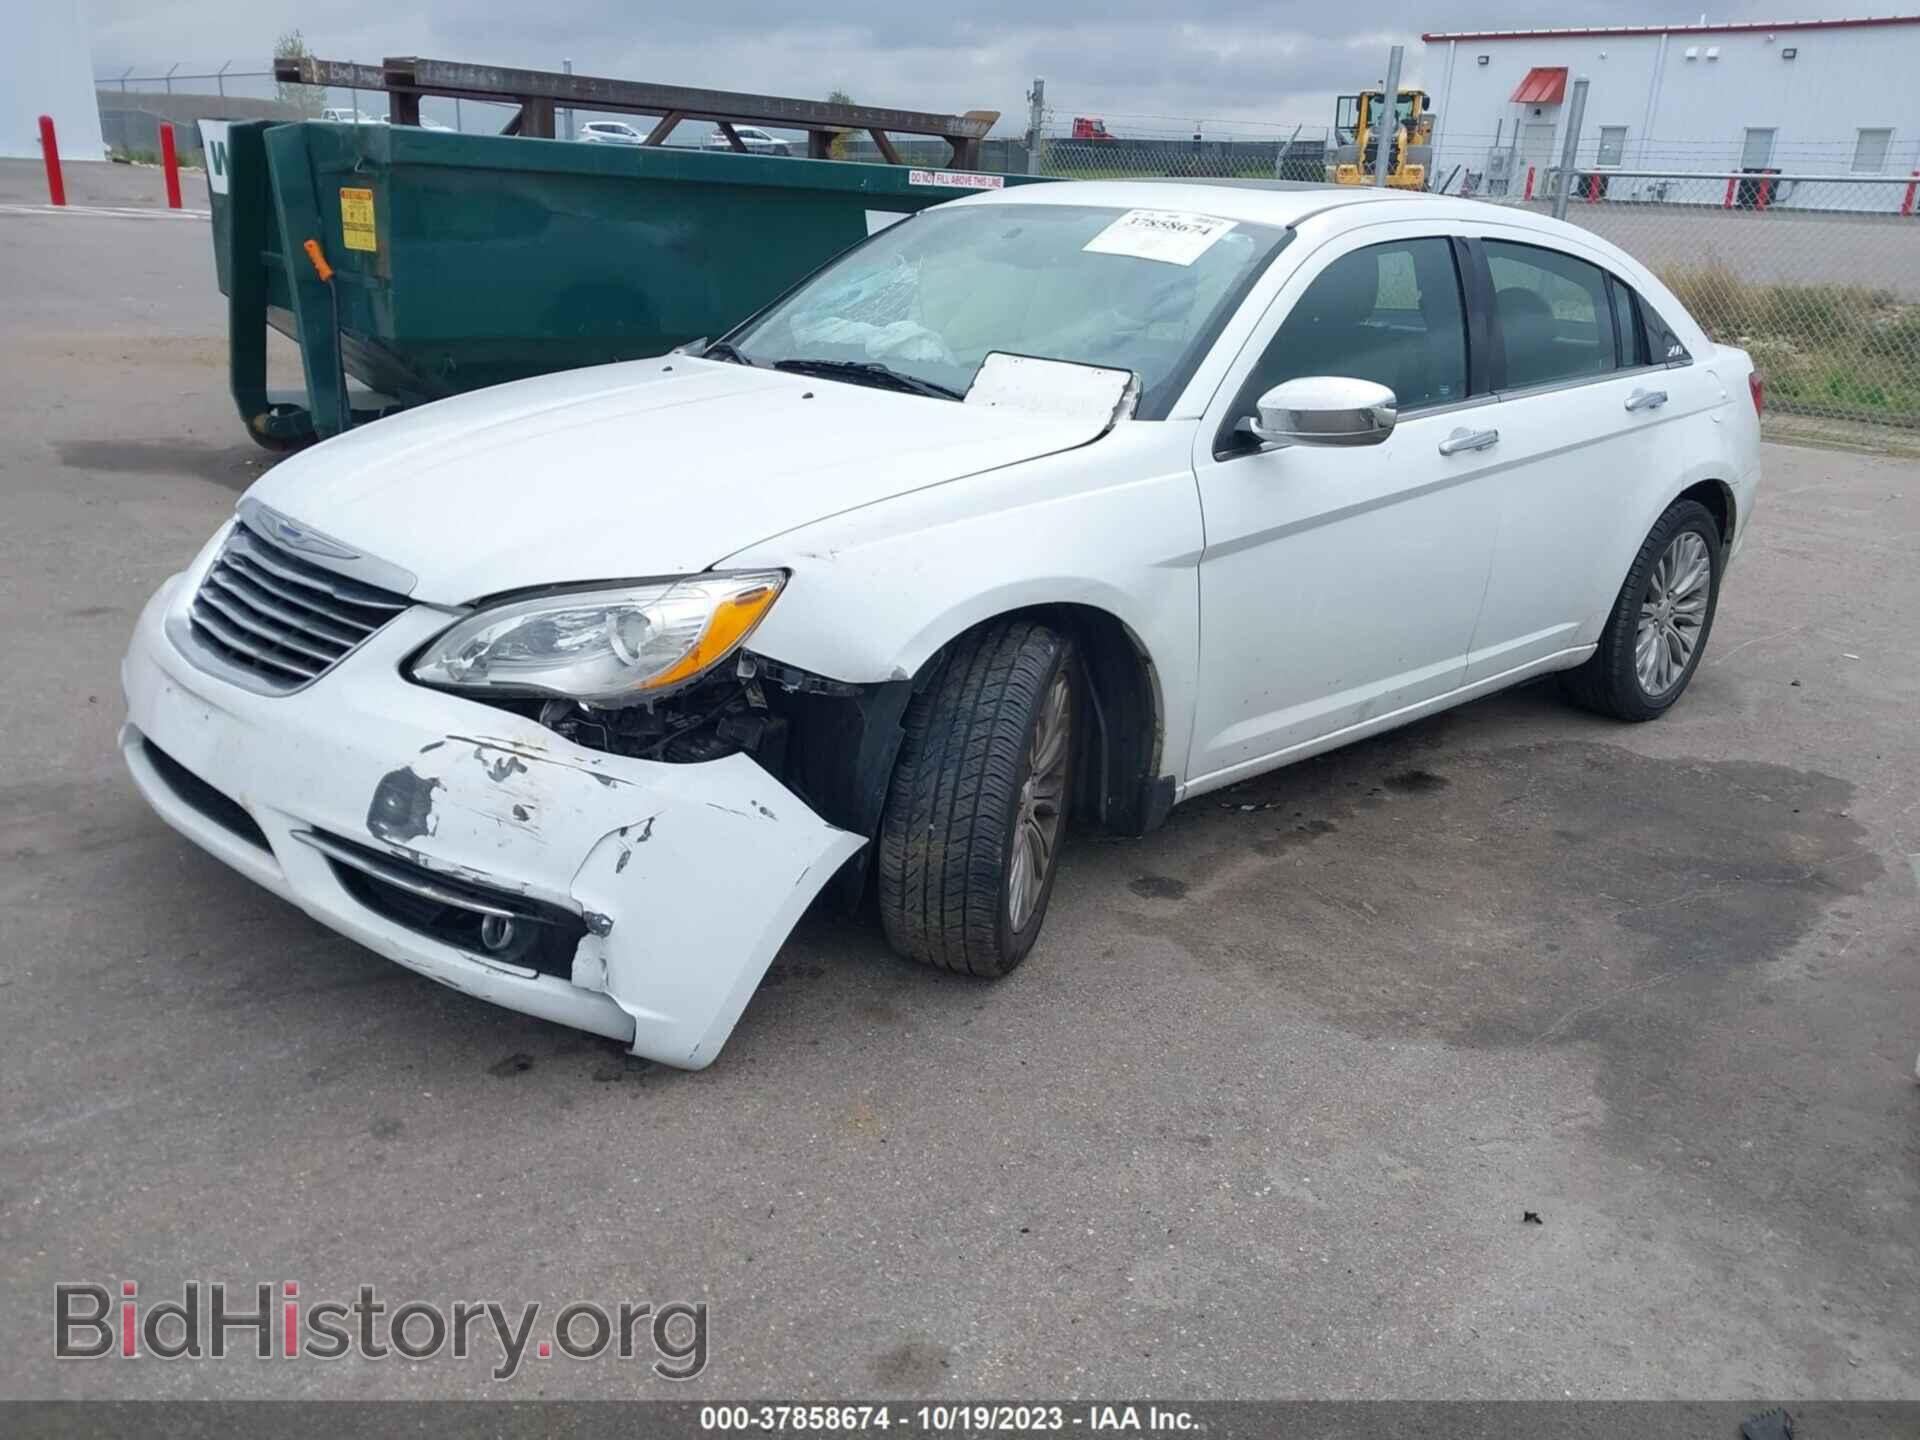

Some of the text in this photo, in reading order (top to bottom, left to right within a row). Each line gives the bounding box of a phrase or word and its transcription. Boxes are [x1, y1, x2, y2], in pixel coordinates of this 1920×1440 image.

[911, 171, 921, 183] DO
[936, 174, 950, 185] FILL
[951, 175, 972, 187] ABOVE
[974, 176, 987, 188] THIS
[988, 177, 1001, 189] LINE
